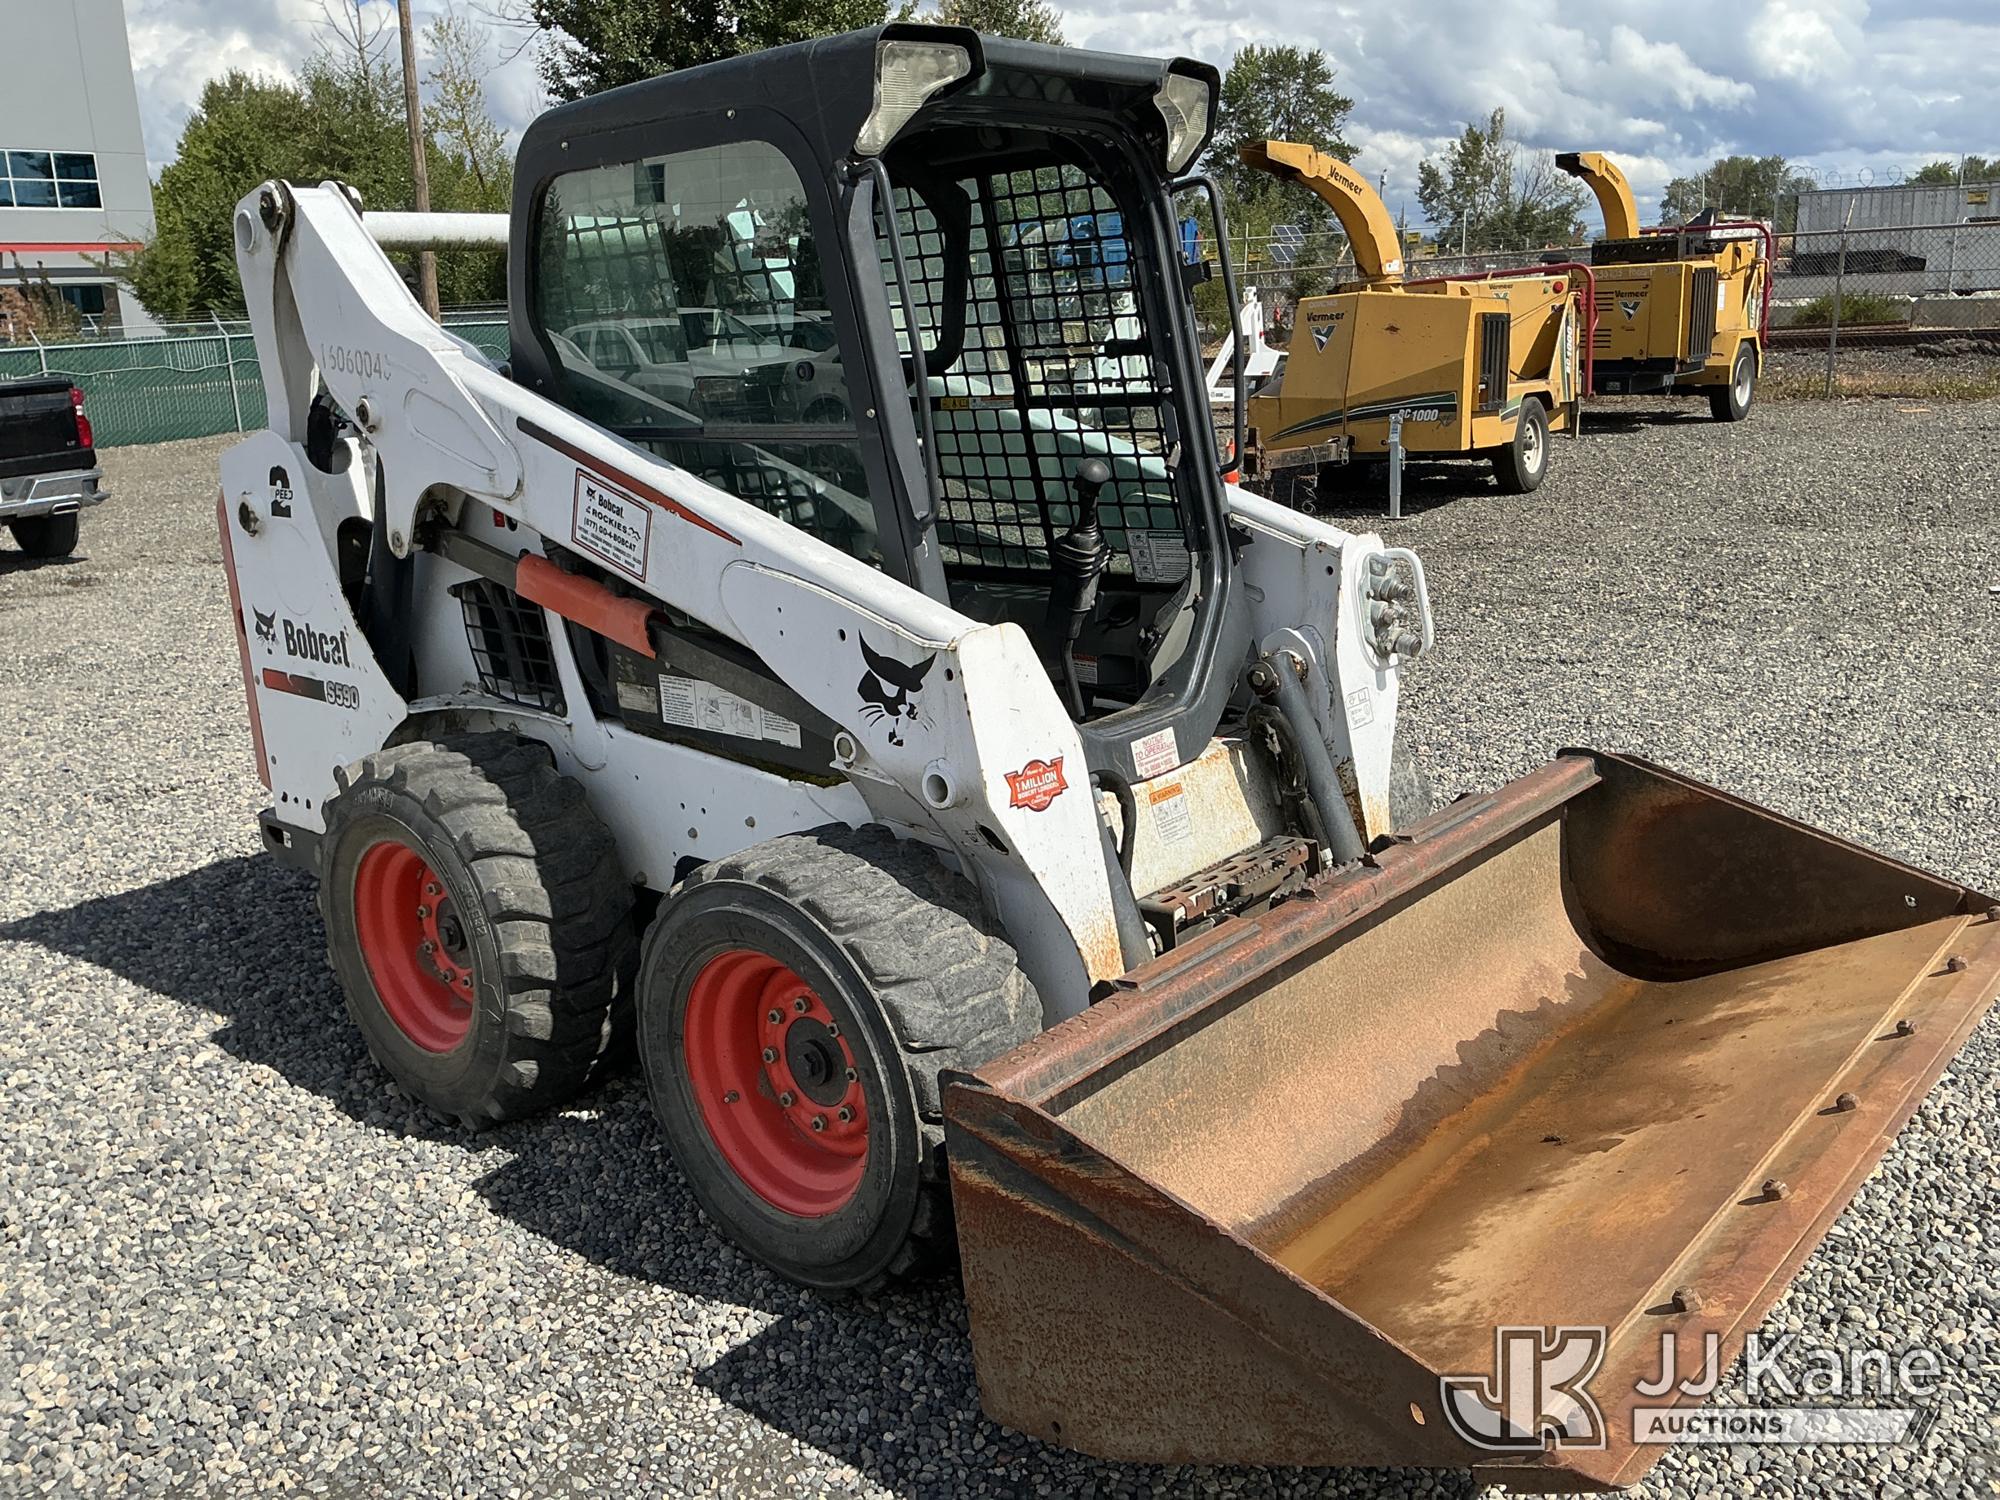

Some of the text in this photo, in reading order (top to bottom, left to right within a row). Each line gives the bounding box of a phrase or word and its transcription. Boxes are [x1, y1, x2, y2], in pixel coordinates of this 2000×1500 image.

[1330, 165, 1363, 196] Vermeer
[1614, 290, 1649, 298] Vermeer
[1306, 312, 1345, 322] Vermeer
[1412, 408, 1439, 422] 1000
[598, 494, 624, 519] Bobcat
[592, 507, 628, 534] ROCKIES
[282, 619, 350, 668] Bobcat
[326, 680, 359, 710] S590
[1021, 770, 1058, 791] MILLION
